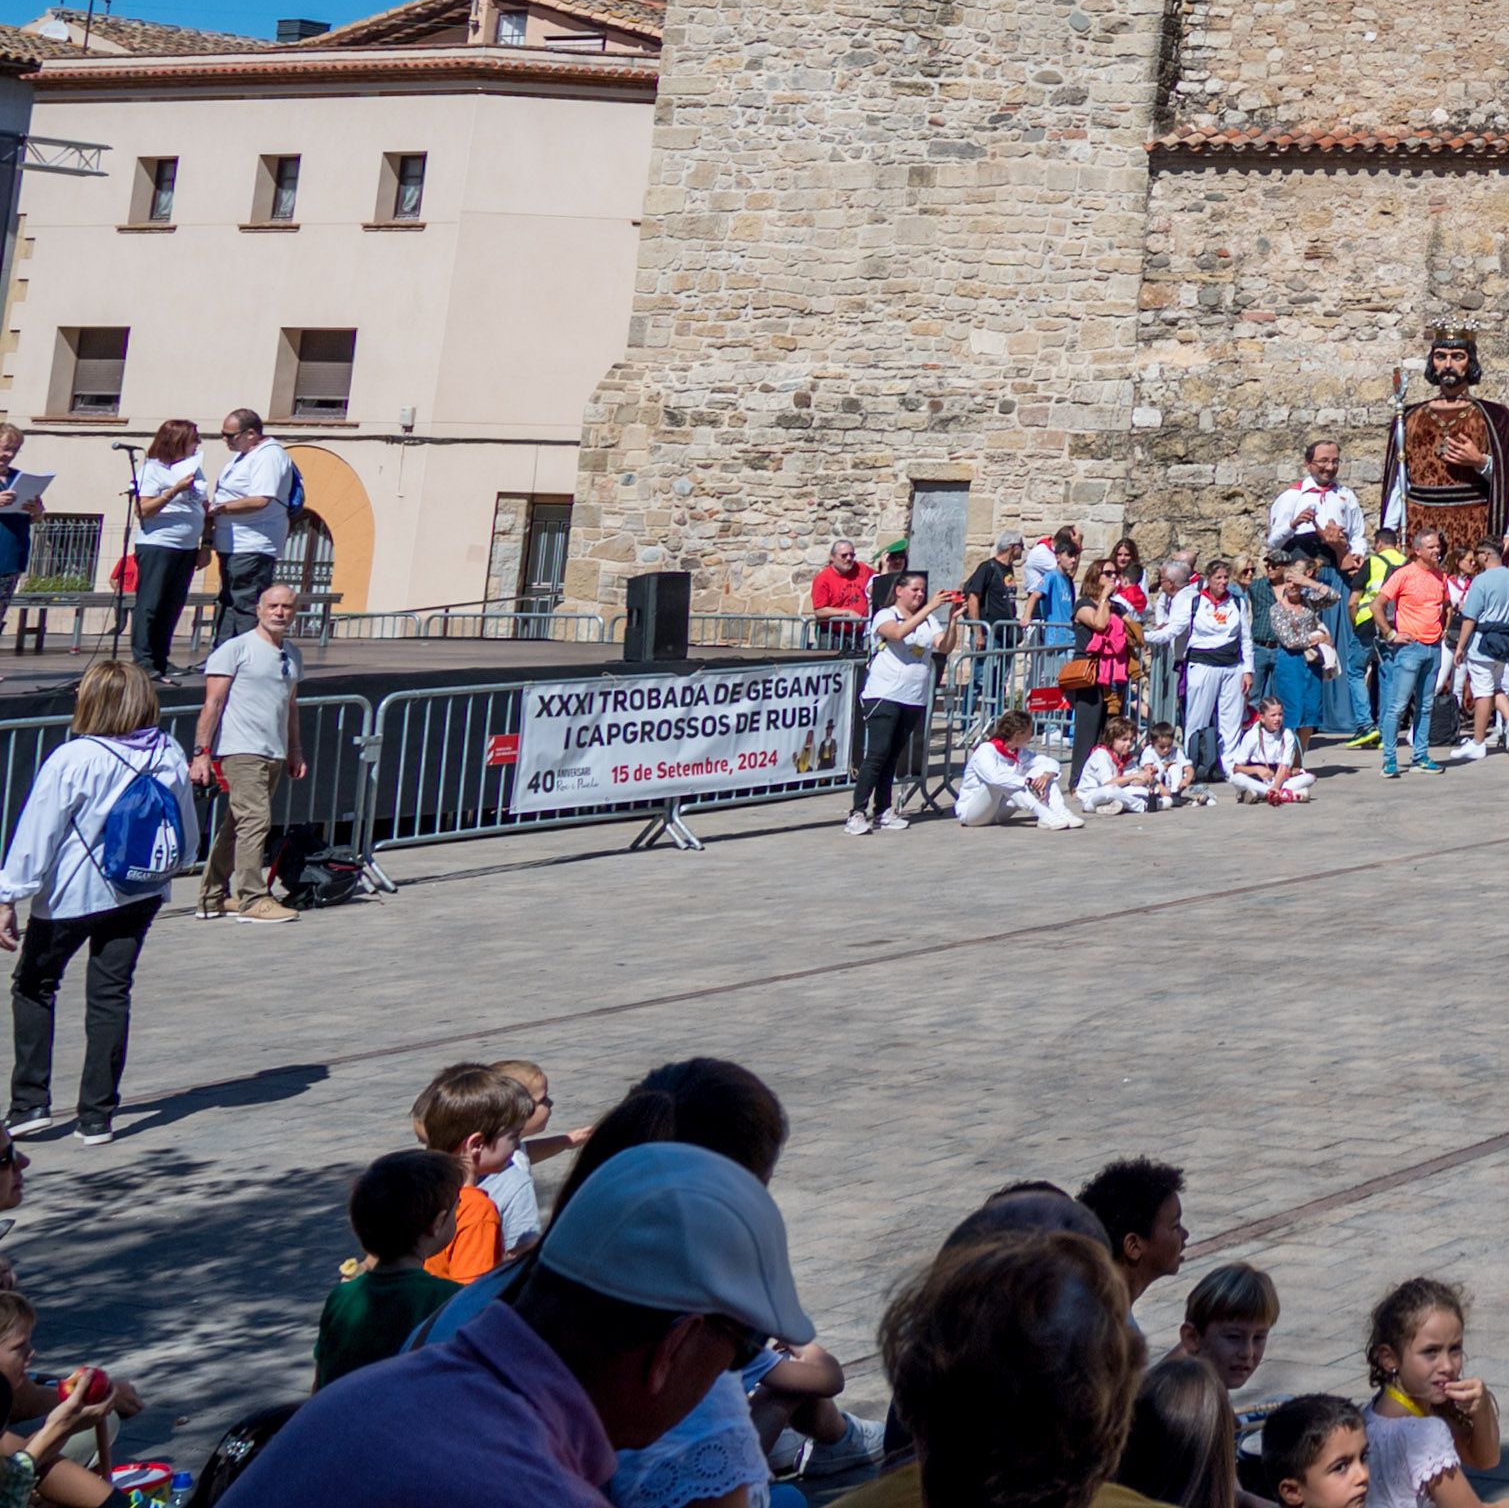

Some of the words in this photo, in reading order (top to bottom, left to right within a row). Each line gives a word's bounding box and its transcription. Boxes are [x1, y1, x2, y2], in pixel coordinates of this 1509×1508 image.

[535, 692, 594, 718] XXXI
[598, 684, 709, 713] TROBADA
[713, 682, 744, 705] DE
[746, 673, 843, 701] GEGANTS
[564, 727, 571, 750] I
[576, 714, 730, 748] CAPGROSSOS
[735, 710, 761, 734] DE
[766, 699, 819, 732] RUBÍ
[527, 770, 555, 793] 40
[557, 767, 591, 778] ANIVERSARI
[611, 765, 629, 784] 15
[634, 763, 652, 781] de
[657, 757, 733, 779] Setembre,
[738, 749, 778, 770] 2024
